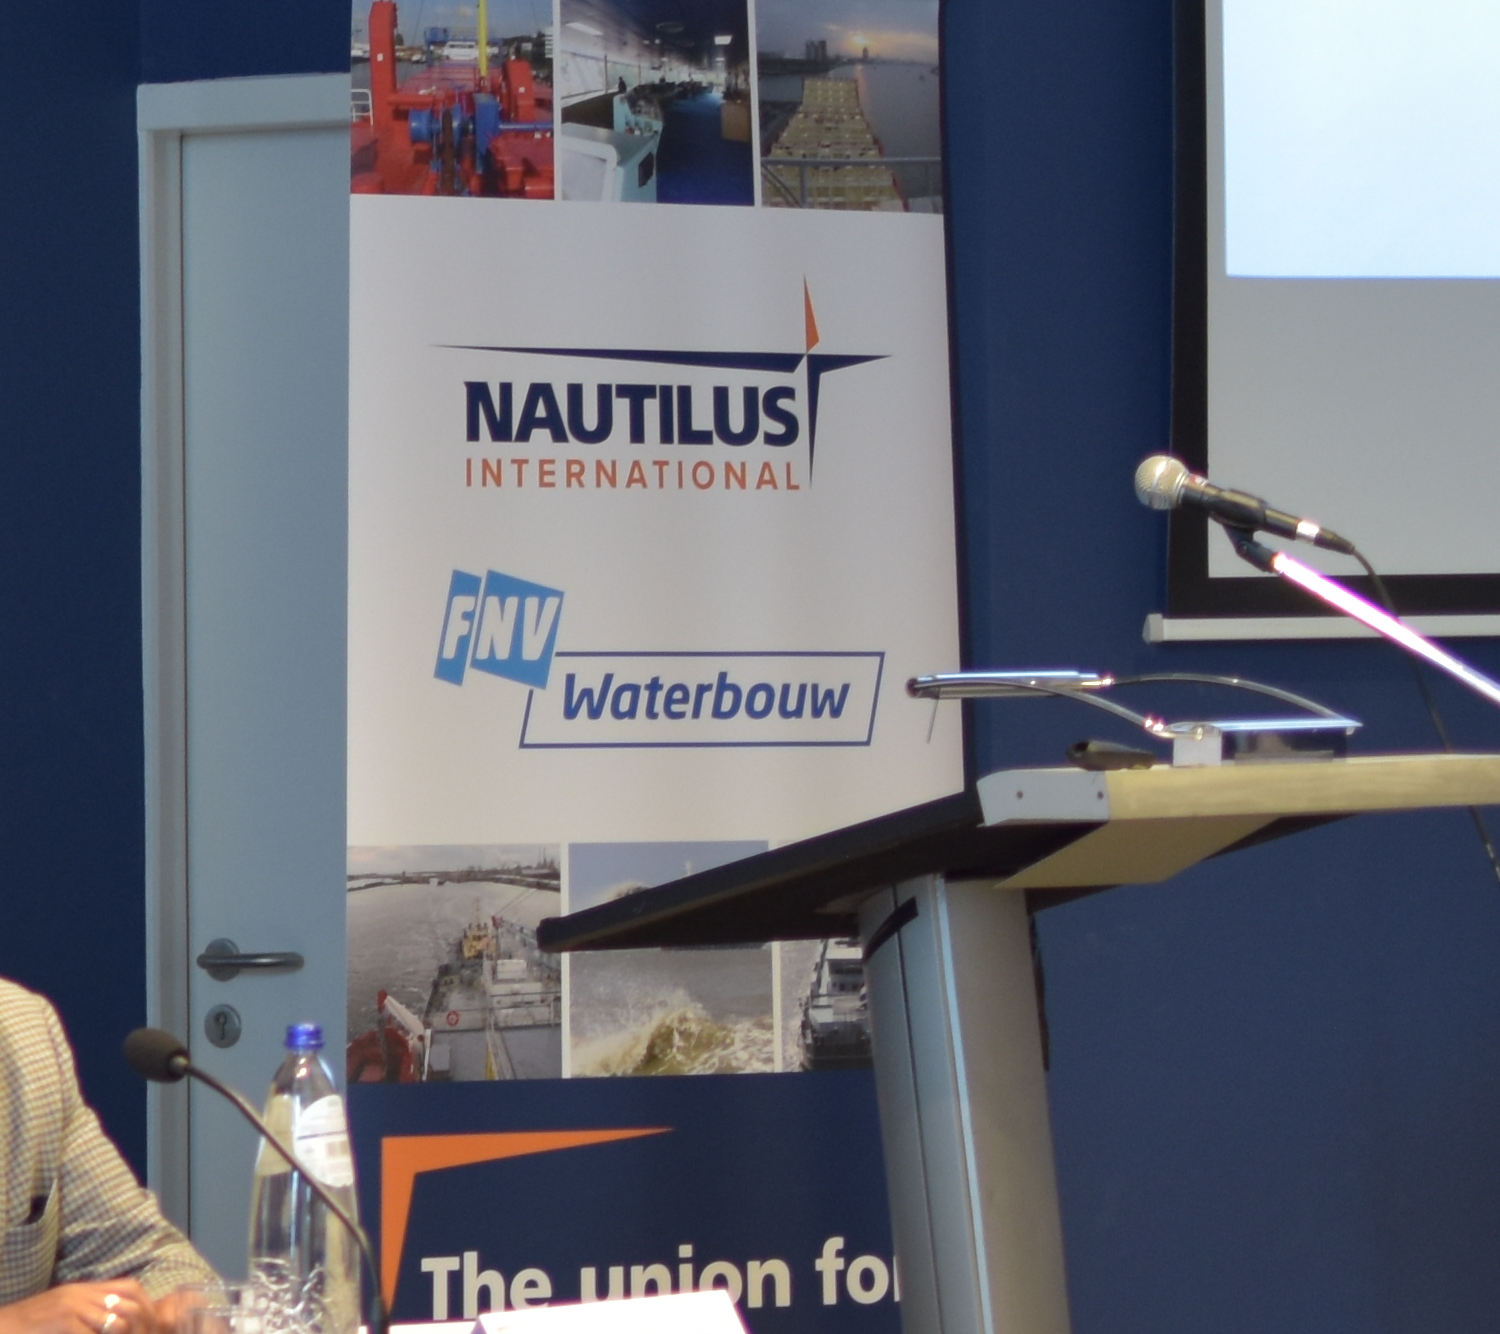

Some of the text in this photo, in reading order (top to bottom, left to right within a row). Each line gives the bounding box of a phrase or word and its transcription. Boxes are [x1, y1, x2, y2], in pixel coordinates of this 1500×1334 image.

[463, 380, 801, 447] NAUTILUS
[465, 457, 800, 491] INTERNATIONAL
[442, 594, 561, 662] FNV
[562, 671, 851, 721] Waterbouw
[420, 1235, 901, 1321] The union fo
